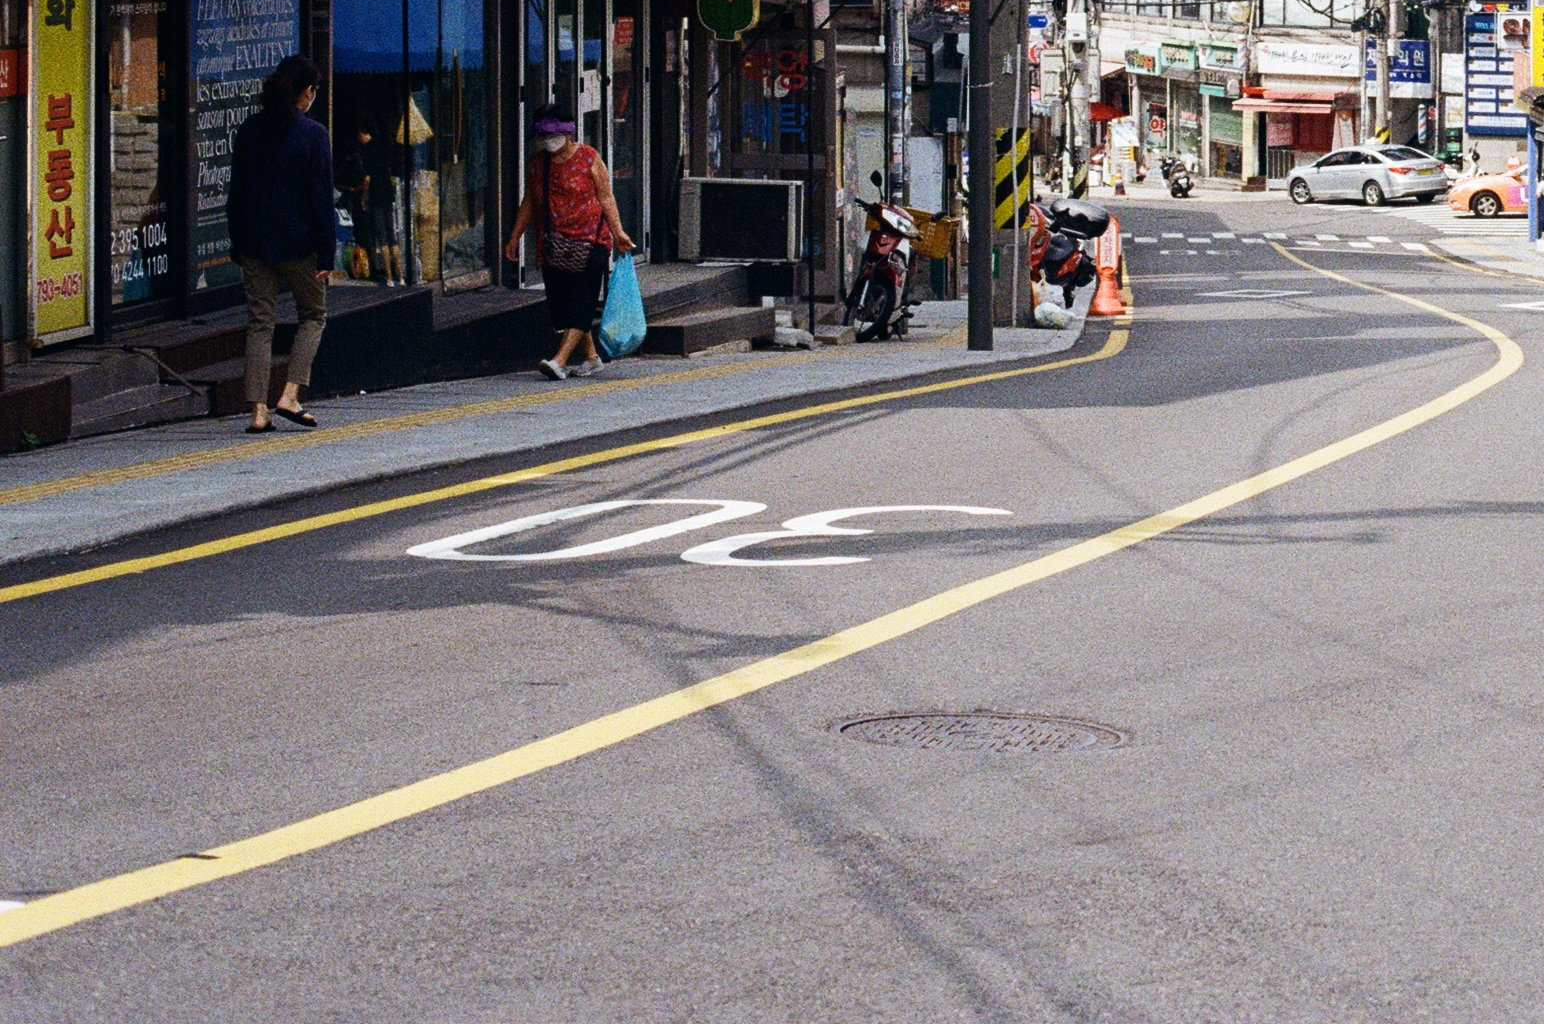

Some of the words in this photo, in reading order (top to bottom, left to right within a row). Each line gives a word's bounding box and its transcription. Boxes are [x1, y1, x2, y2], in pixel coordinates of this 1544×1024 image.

[44, 92, 76, 259] 부동산
[118, 226, 139, 254] 395
[142, 221, 168, 249] 1004
[147, 253, 169, 277] 1100
